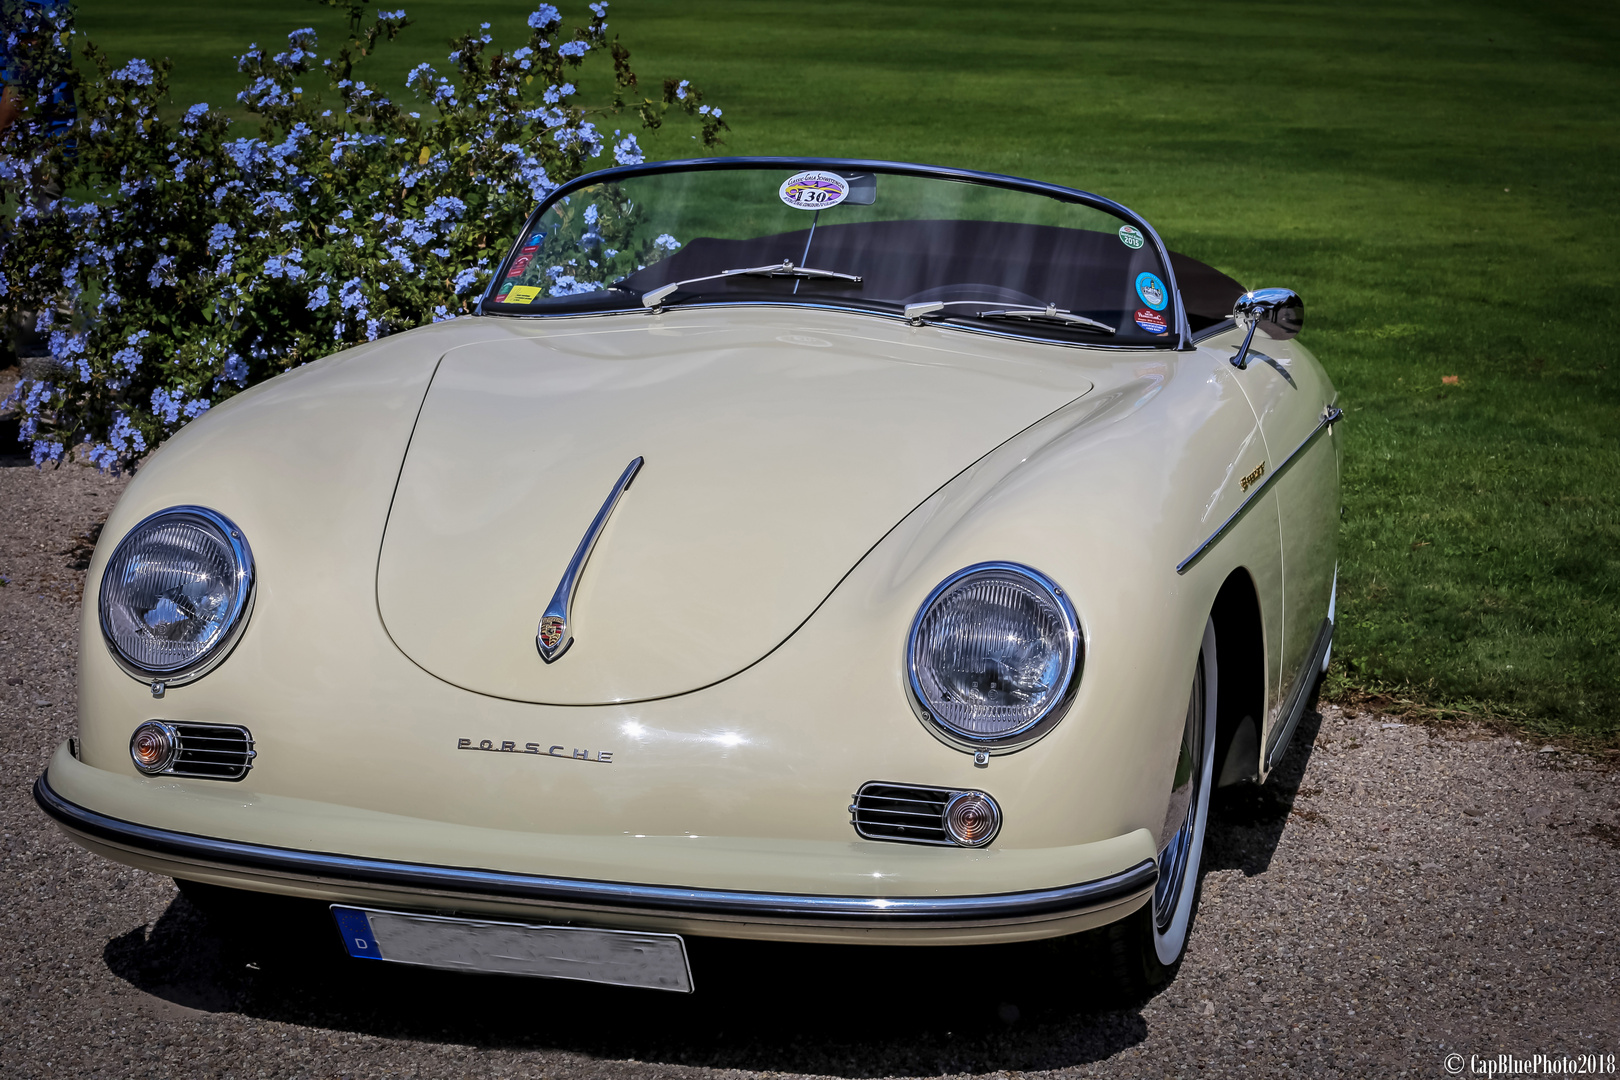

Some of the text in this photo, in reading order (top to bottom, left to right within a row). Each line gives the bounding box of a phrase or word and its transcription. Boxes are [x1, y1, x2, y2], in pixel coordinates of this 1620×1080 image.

[796, 191, 827, 203] 130
[1124, 236, 1140, 247] 2015
[457, 738, 614, 763] PORSCHE
[354, 938, 368, 949] D
